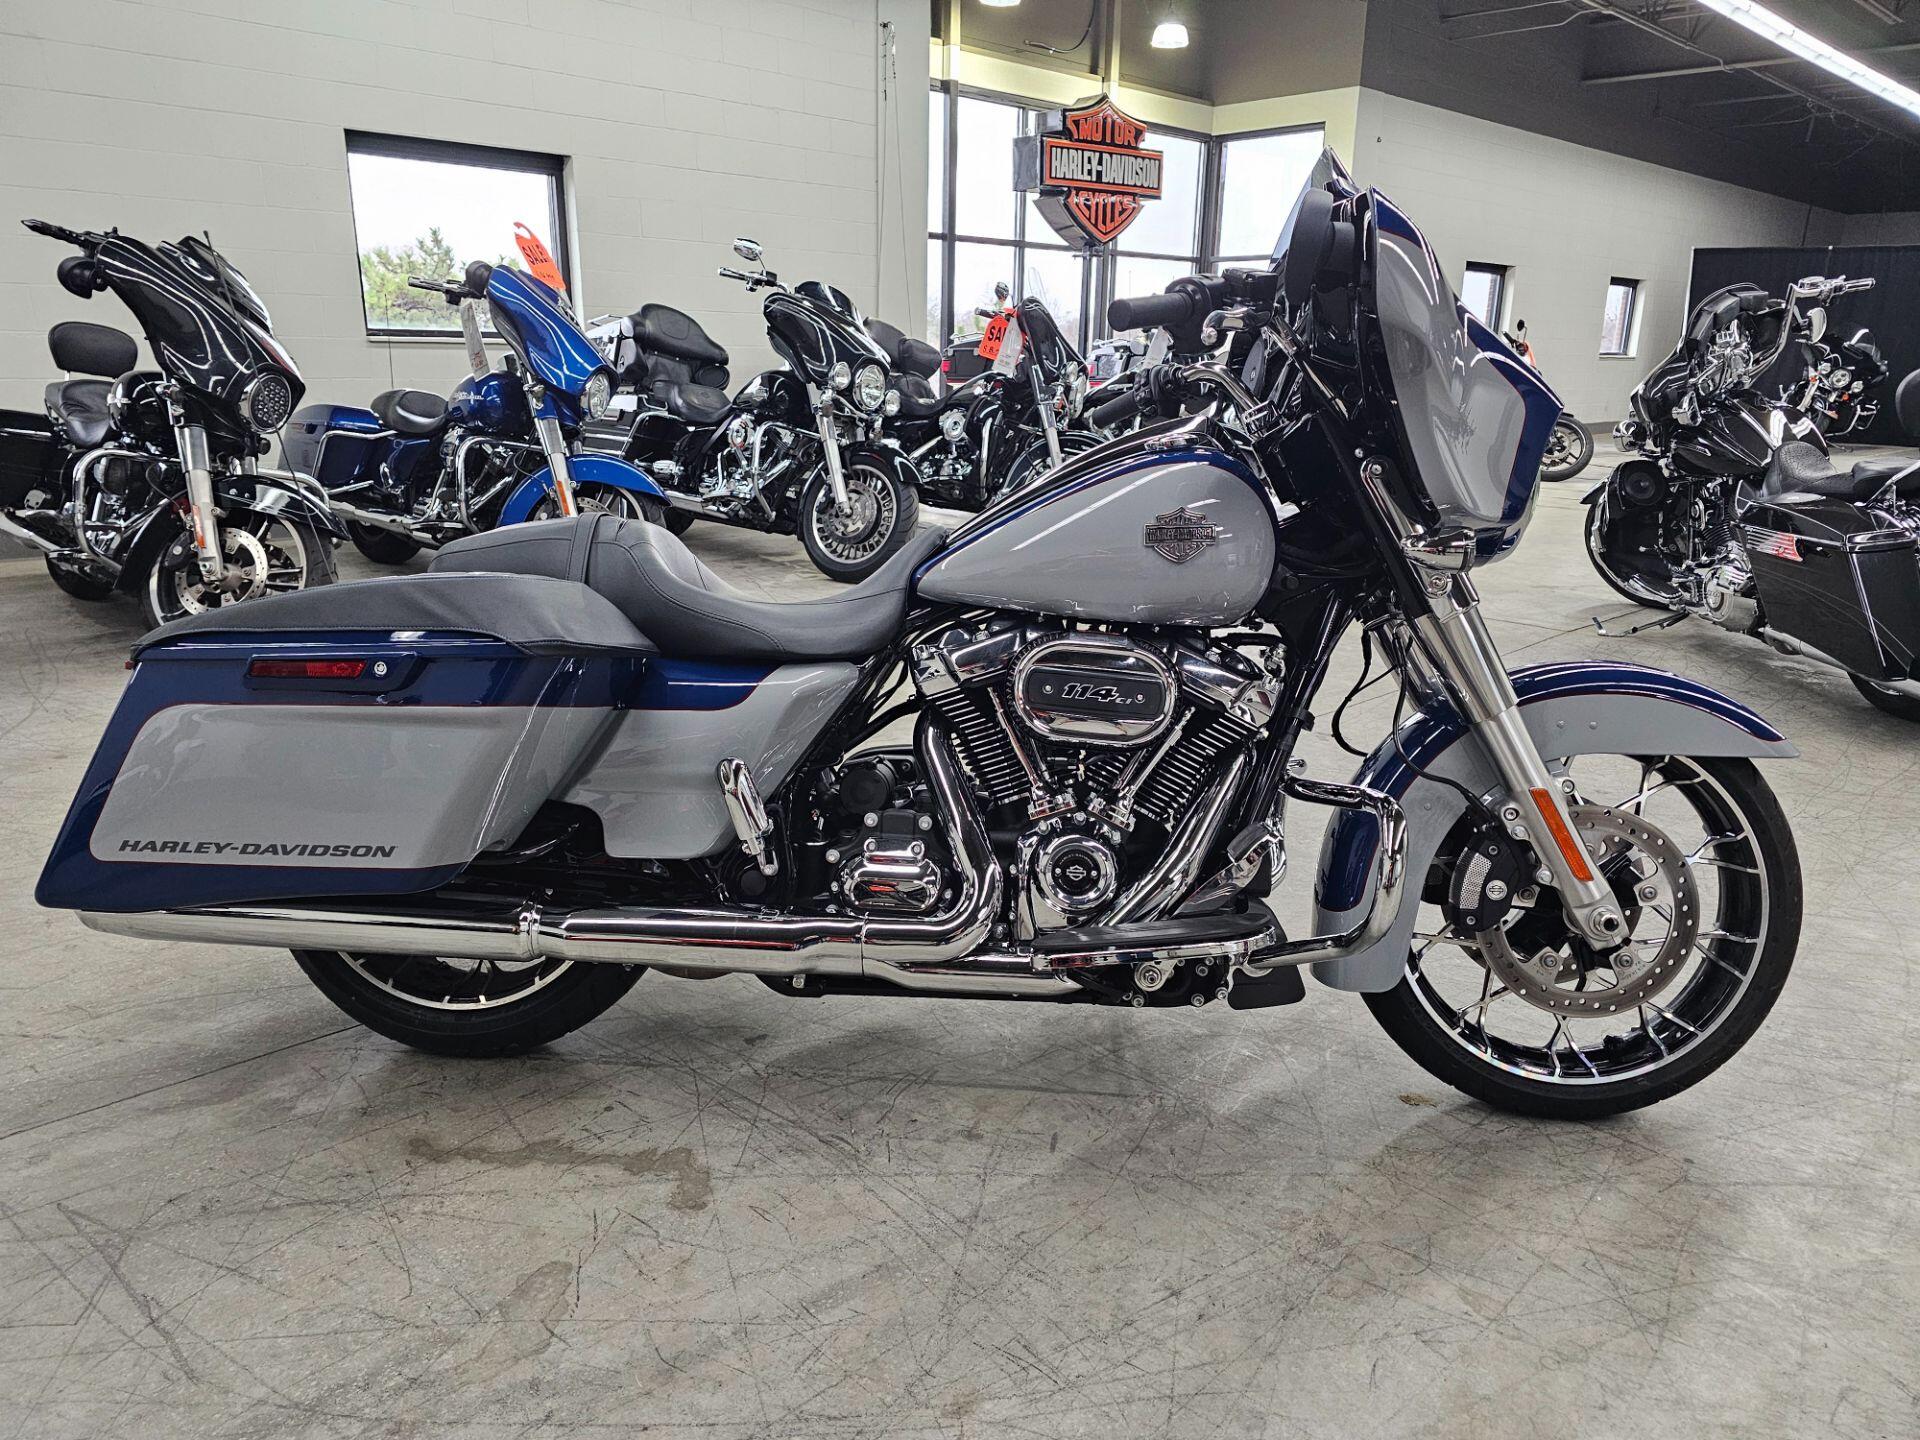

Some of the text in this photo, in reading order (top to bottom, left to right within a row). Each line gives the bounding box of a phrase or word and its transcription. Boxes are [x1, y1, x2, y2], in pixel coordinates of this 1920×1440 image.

[1079, 111, 1136, 147] MOTOR
[1051, 147, 1160, 189] HARLEY-DAVIDSON
[1077, 190, 1135, 233] CYCLES
[1061, 682, 1120, 703] 114
[118, 839, 398, 858] HARLEY-DAVIDSON
